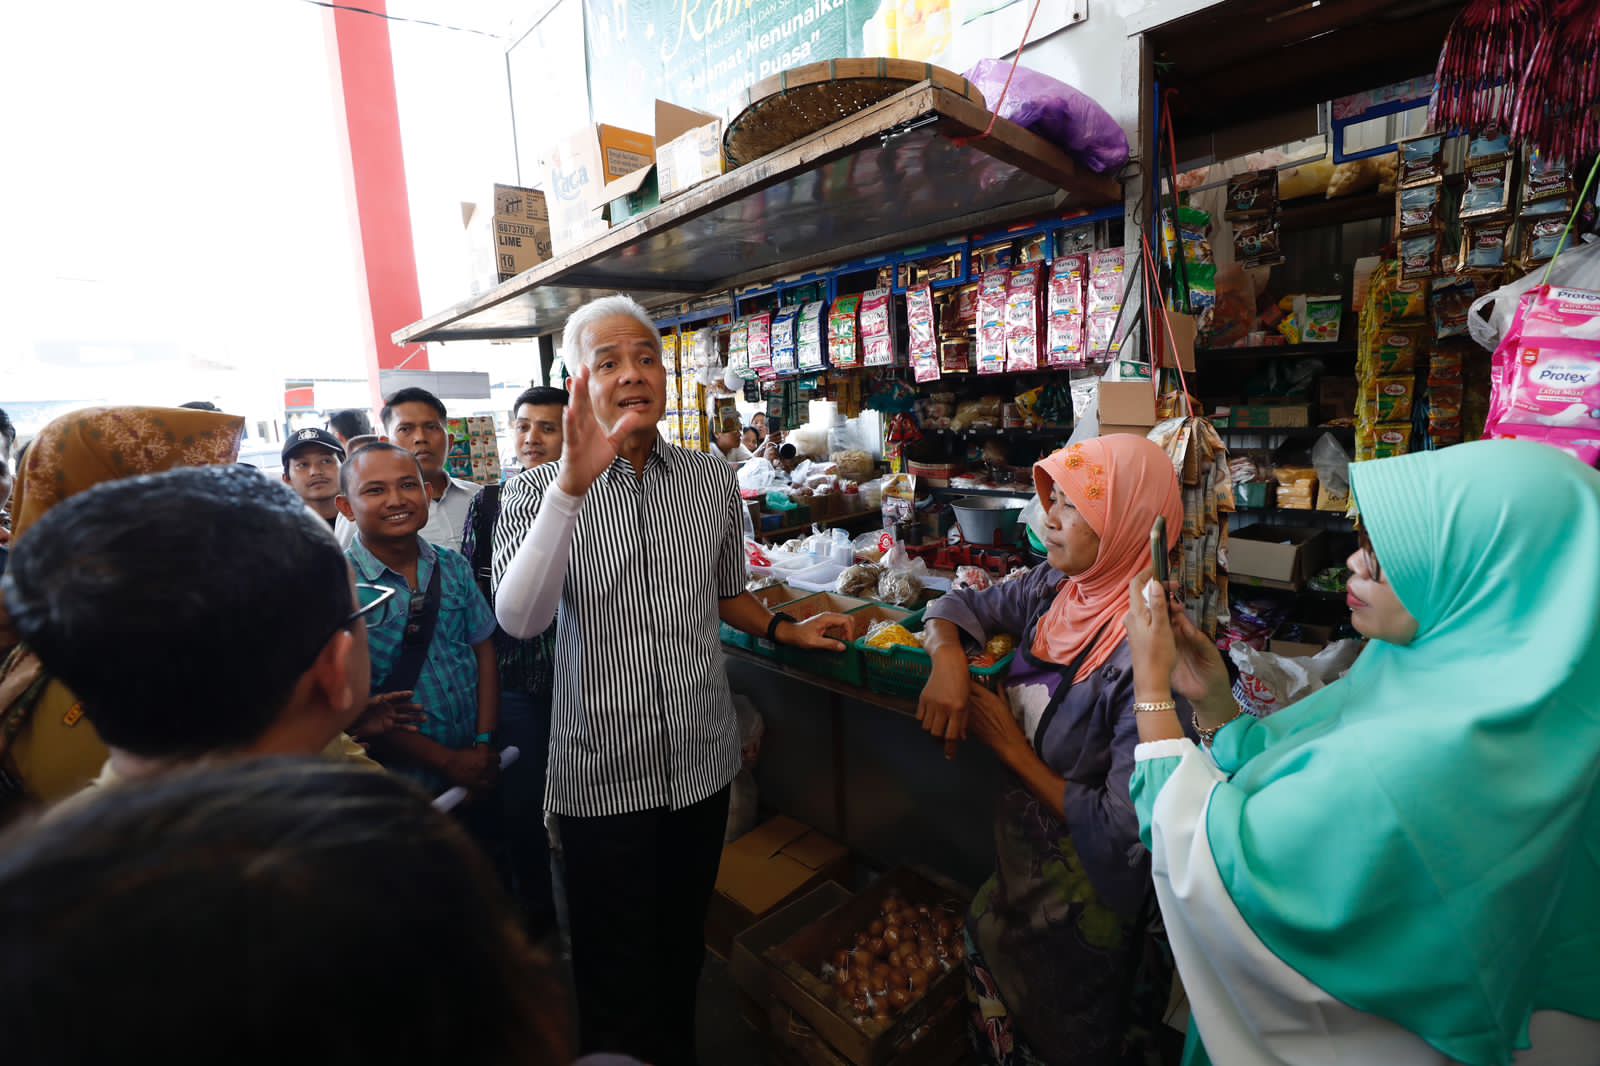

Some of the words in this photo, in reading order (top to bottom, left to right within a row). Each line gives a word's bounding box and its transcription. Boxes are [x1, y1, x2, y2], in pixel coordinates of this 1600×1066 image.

[746, 0, 847, 58] Menunaika
[499, 235, 522, 248] LIME
[1539, 369, 1589, 383] Protex
